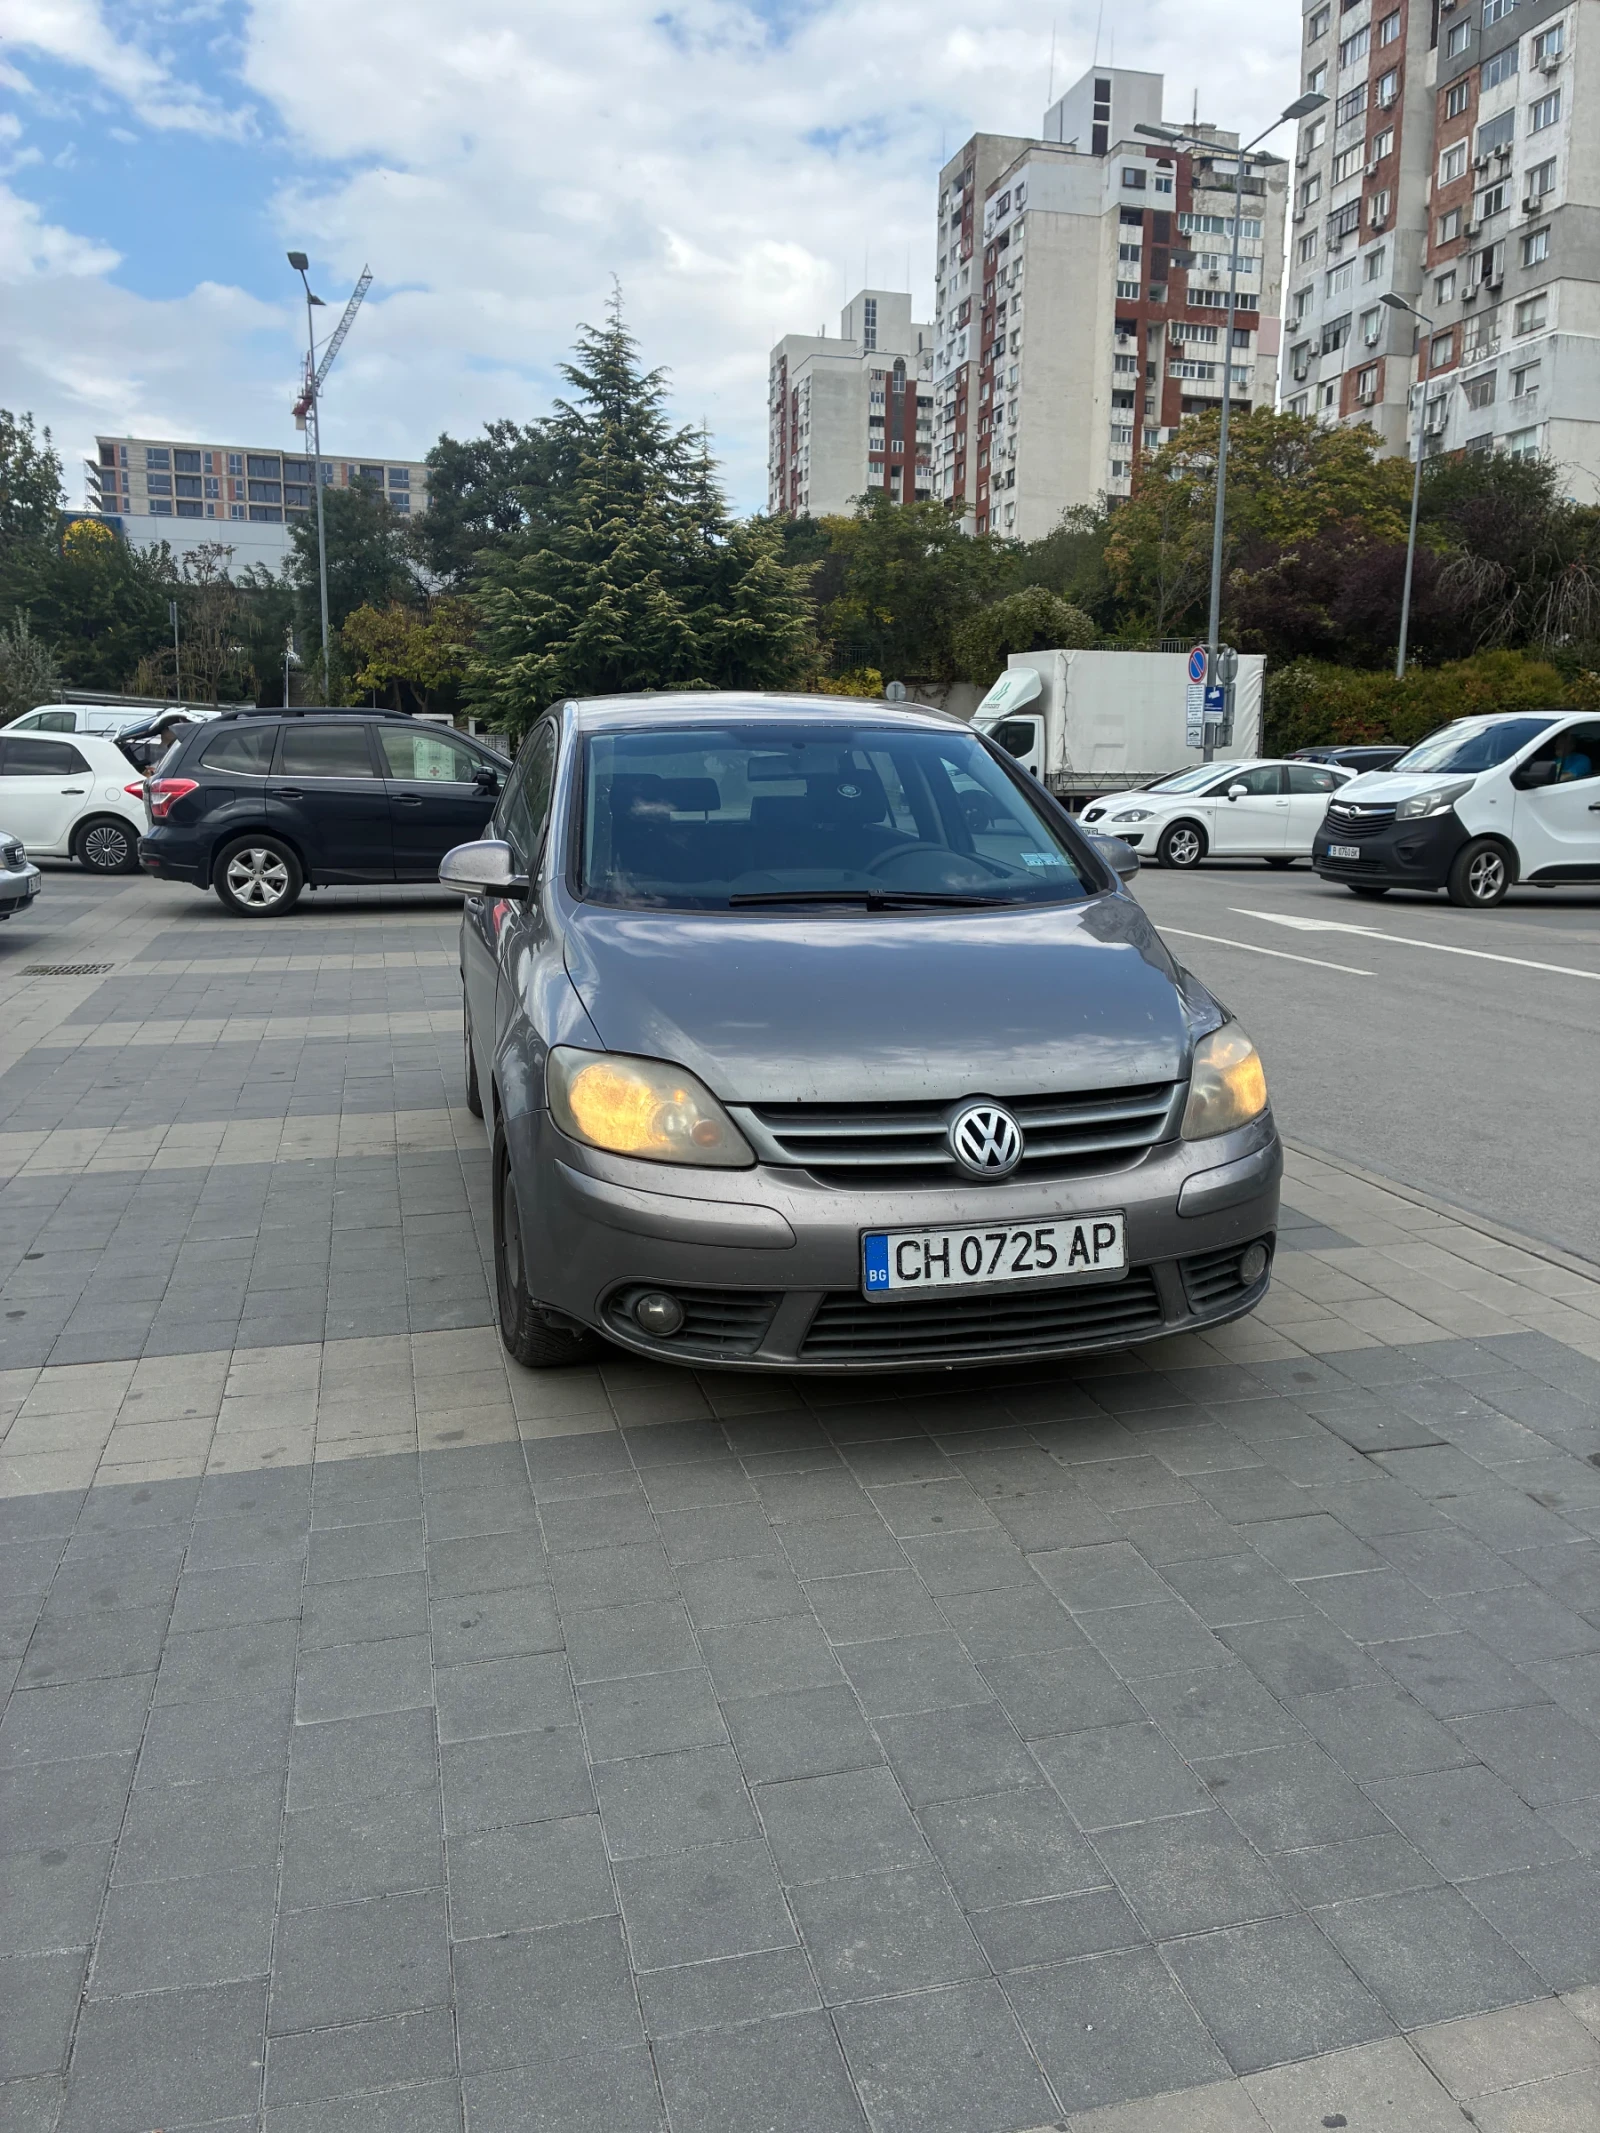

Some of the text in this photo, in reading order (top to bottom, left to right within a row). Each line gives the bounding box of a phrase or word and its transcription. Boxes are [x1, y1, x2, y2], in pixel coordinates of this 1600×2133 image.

[952, 1106, 1022, 1174] VW
[869, 1270, 887, 1282] BG
[895, 1222, 1116, 1281] CH 0725 AP
